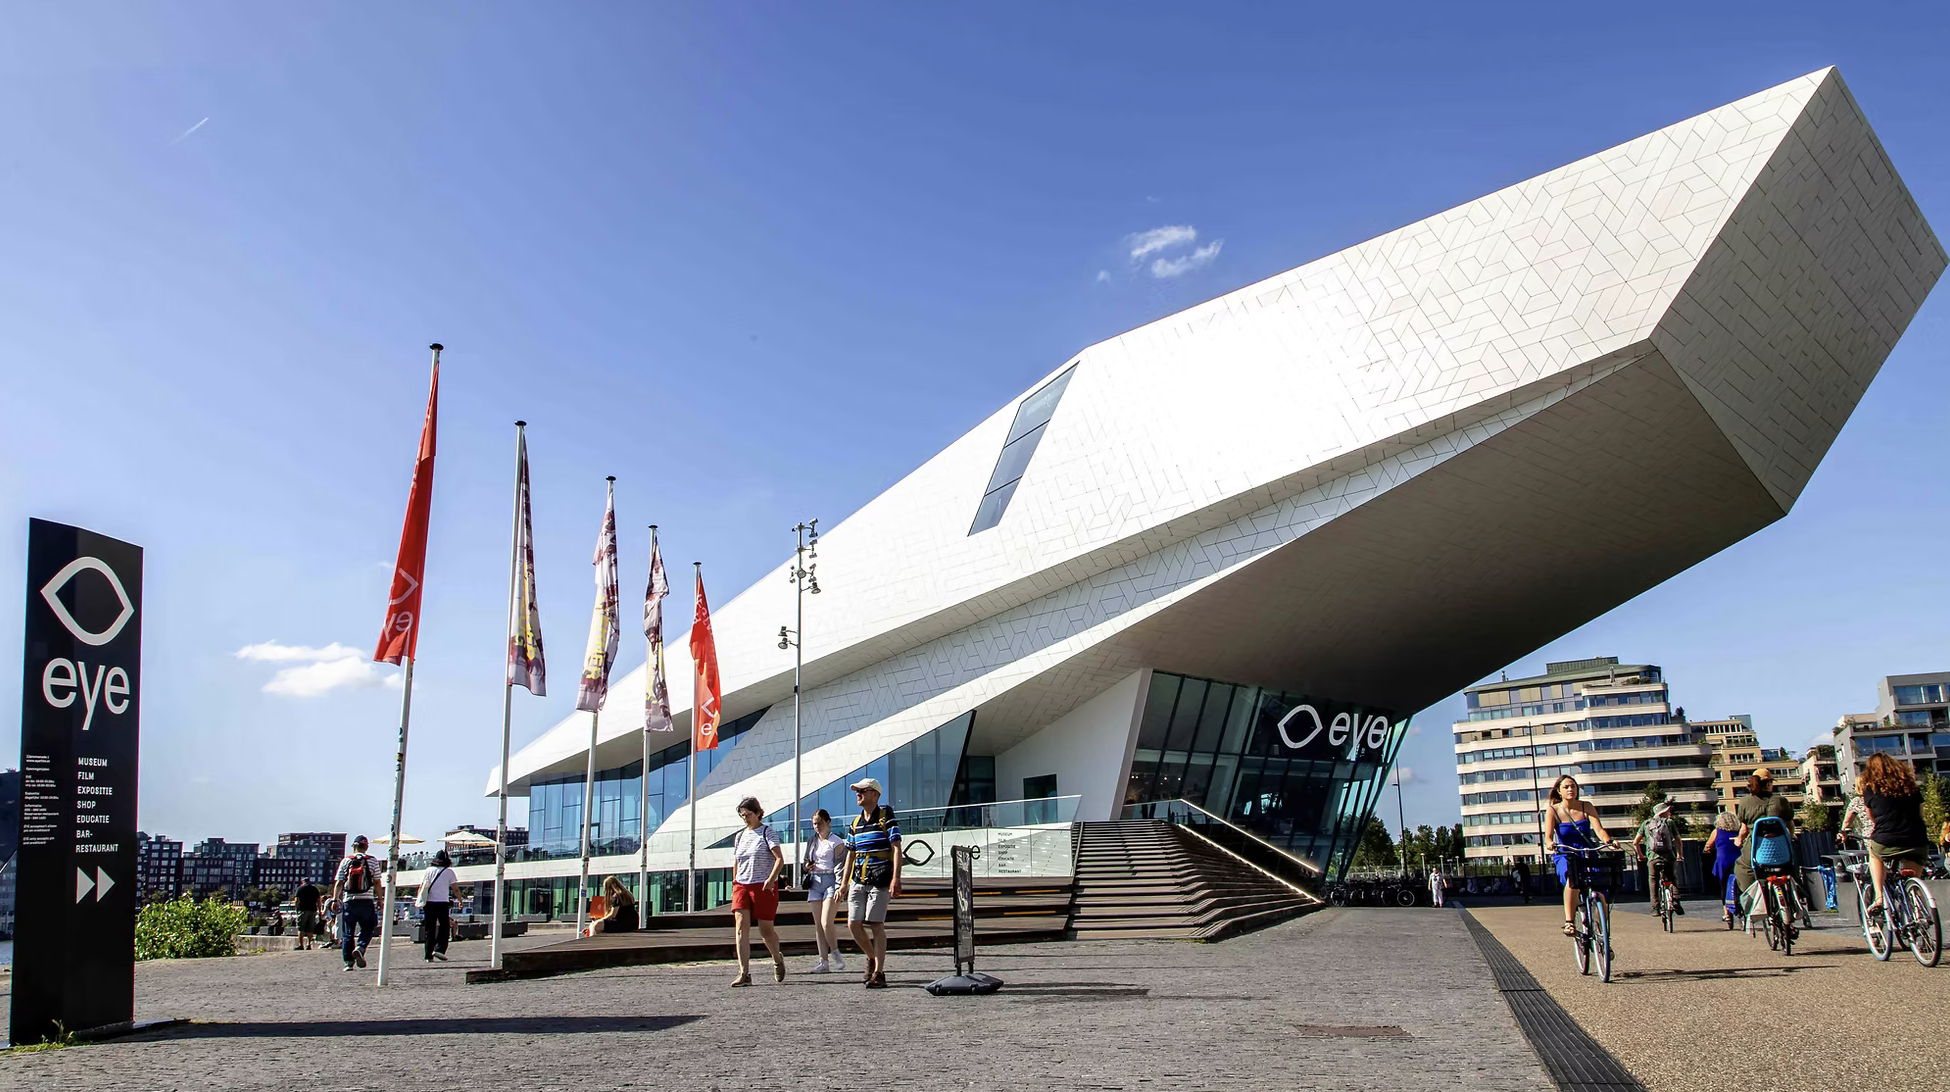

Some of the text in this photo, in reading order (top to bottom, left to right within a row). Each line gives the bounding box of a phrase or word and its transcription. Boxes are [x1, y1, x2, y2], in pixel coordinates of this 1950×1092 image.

[42, 657, 131, 731] eye
[1328, 712, 1389, 762] eye
[78, 757, 107, 767] MUSEUM
[77, 772, 94, 780] FILM
[77, 786, 113, 795] EXPOSITIE
[76, 801, 96, 809] SHOP
[76, 815, 110, 824] EDUCATIE
[76, 830, 93, 838] BAR-
[75, 844, 119, 853] RESTAURANT
